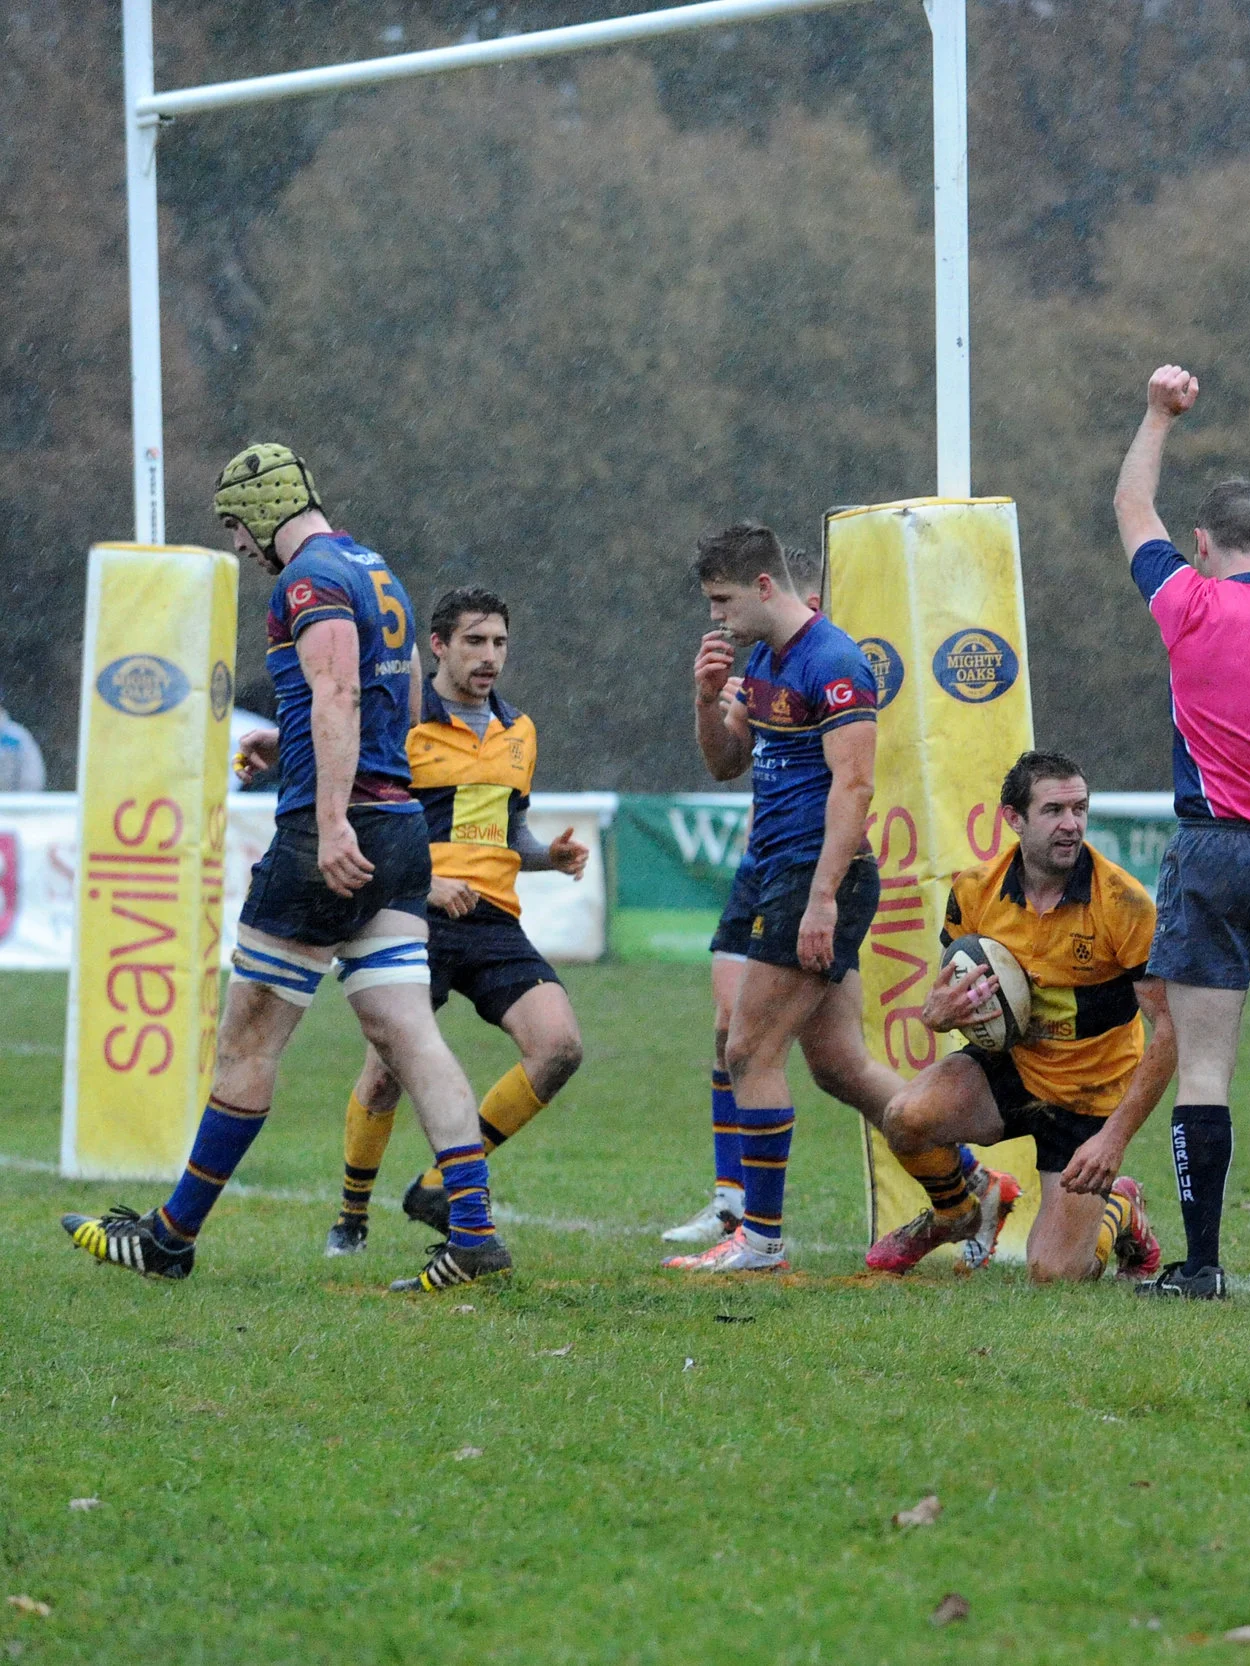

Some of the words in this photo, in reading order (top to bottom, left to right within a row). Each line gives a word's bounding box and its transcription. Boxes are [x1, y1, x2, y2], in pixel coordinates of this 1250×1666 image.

[287, 583, 311, 609] IG
[369, 570, 407, 649] 5
[947, 653, 1003, 669] MIGHTY
[956, 668, 996, 681] OAKS
[825, 683, 853, 707] IG
[455, 823, 506, 844] savills
[88, 797, 184, 1076] savills
[1172, 1123, 1195, 1202] KSRFUR
